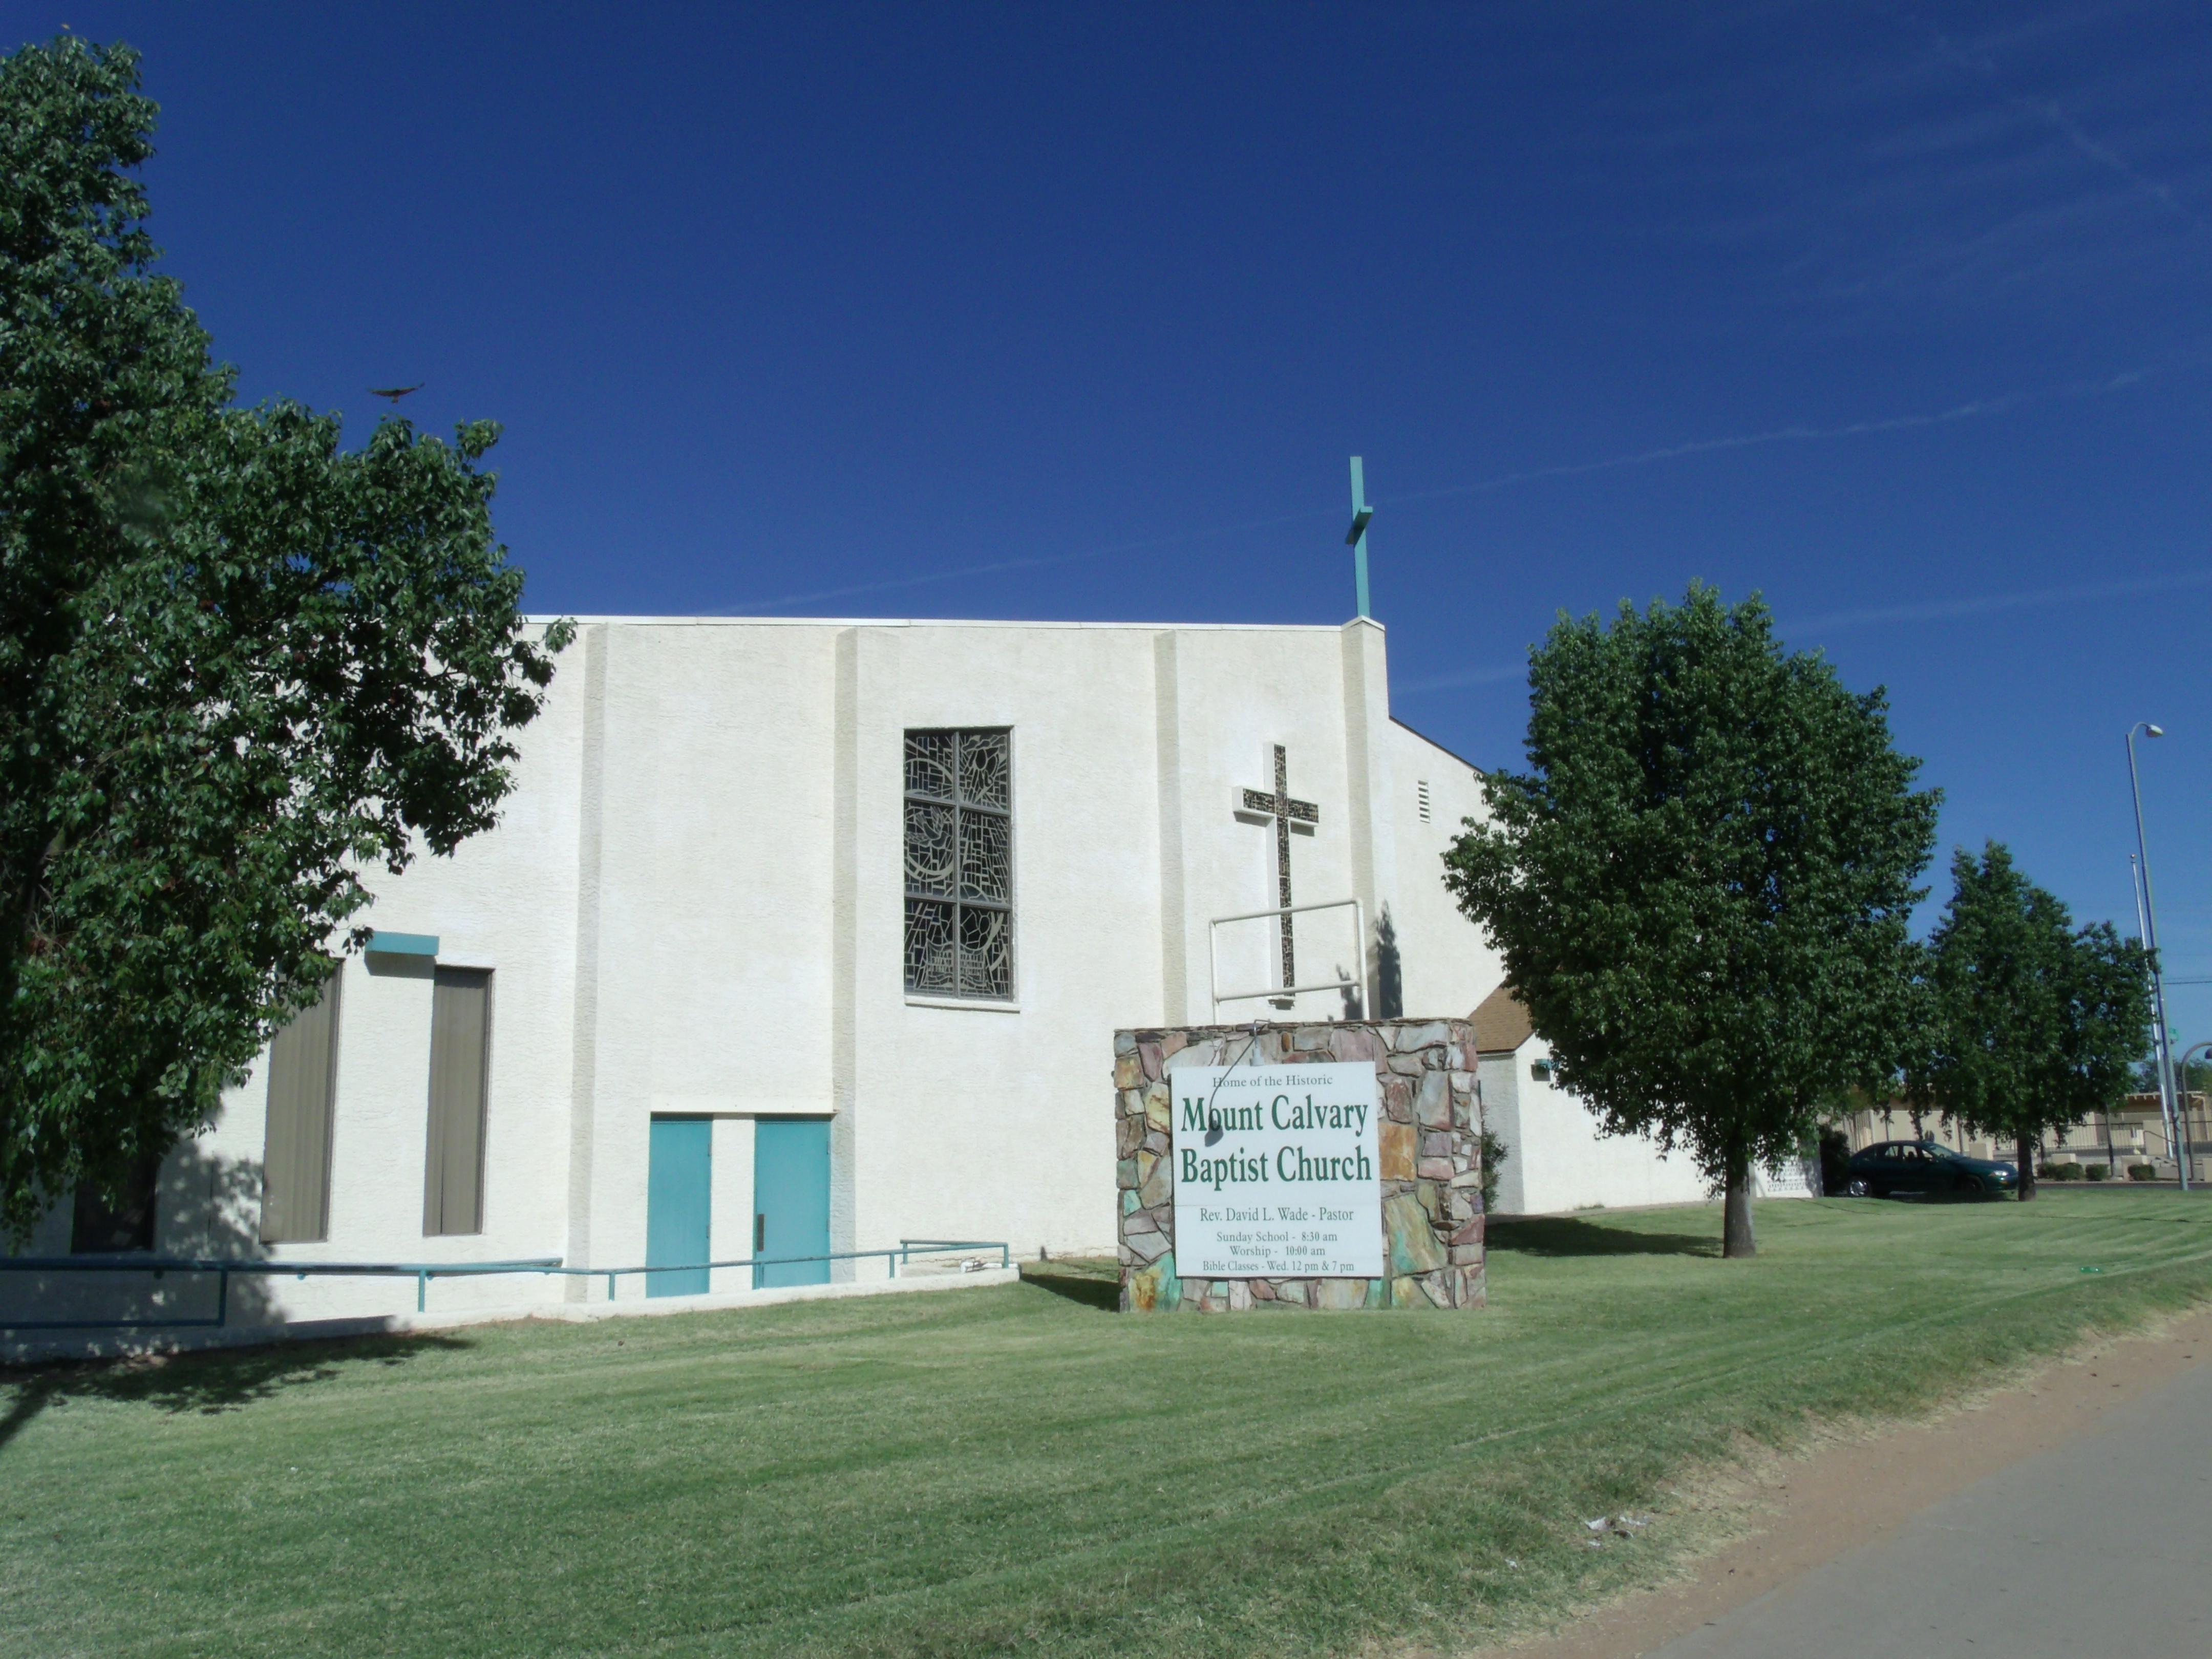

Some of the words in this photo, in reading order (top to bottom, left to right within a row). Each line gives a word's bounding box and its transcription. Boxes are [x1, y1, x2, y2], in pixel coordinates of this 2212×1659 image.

[1213, 1077, 1247, 1088] Home
[1250, 1076, 1262, 1087] of
[1264, 1077, 1282, 1086] the
[1286, 1074, 1333, 1086] Historic
[1181, 1097, 1264, 1132] Mount
[1271, 1094, 1368, 1137] Calvary
[1181, 1147, 1269, 1191] Baptist
[1277, 1145, 1372, 1182] Church
[1200, 1208, 1223, 1221] Rev.
[1226, 1207, 1259, 1221] David
[1263, 1208, 1274, 1221] L.
[1278, 1207, 1308, 1221] Wade
[1320, 1207, 1354, 1221] Pastor
[1217, 1232, 1252, 1243] Sunday
[1256, 1231, 1288, 1242] School
[1302, 1233, 1320, 1242] 8:30
[1229, 1246, 1271, 1258] Worship
[1286, 1246, 1307, 1256] 10:00
[1203, 1261, 1225, 1271] Bible
[1228, 1261, 1259, 1271] Classes
[1267, 1261, 1289, 1271] Wed.
[1292, 1261, 1302, 1270] 12
[1305, 1263, 1318, 1273] pm
[1322, 1261, 1329, 1270] &
[1332, 1261, 1337, 1270] 7
[1340, 1263, 1354, 1273] pm
